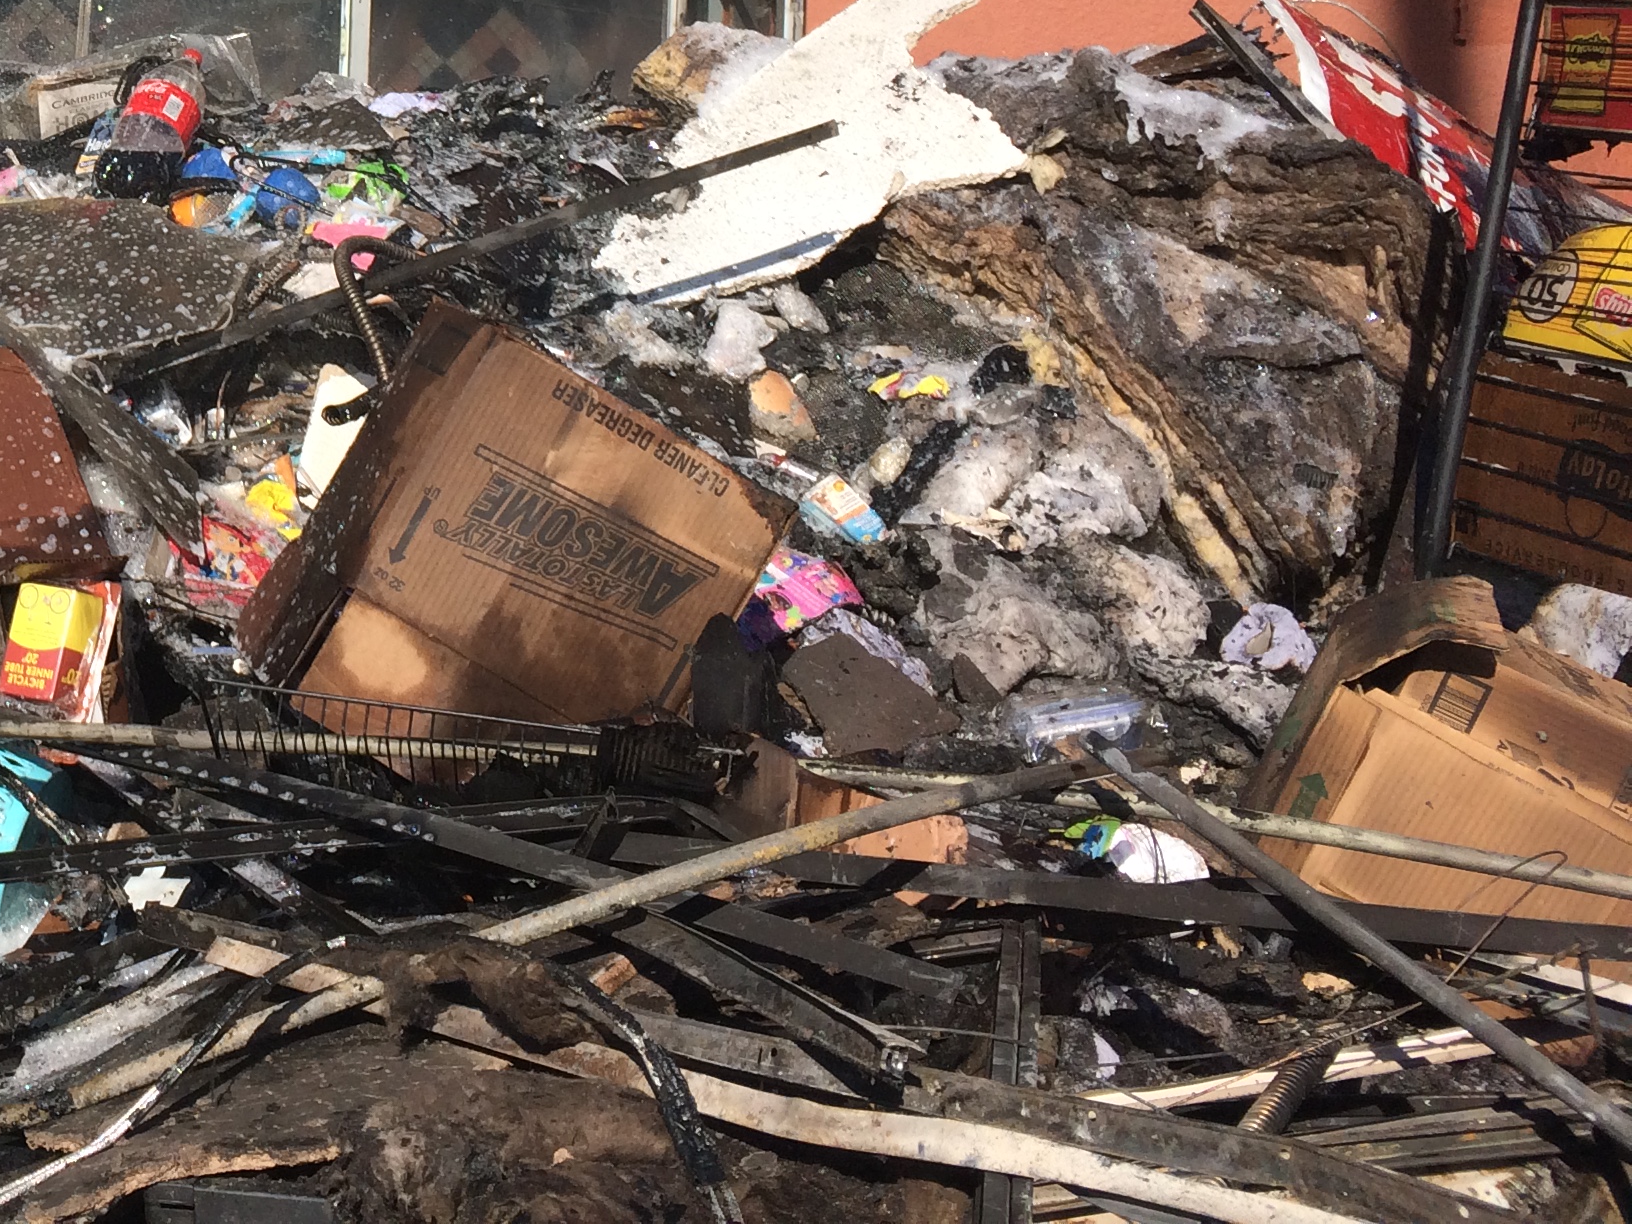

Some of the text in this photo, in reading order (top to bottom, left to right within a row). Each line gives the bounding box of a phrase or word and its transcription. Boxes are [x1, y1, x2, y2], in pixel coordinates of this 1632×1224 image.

[51, 88, 116, 110] CAMBRIDG
[1527, 276, 1565, 310] 50
[550, 378, 656, 452] DEGREASER
[423, 484, 442, 501] UP
[445, 518, 580, 587] TOTALLY
[466, 470, 708, 621] AWESOME
[388, 575, 406, 593] 32
[4, 661, 54, 681] INNER TUBE
[7, 673, 46, 691] BICYCLE
